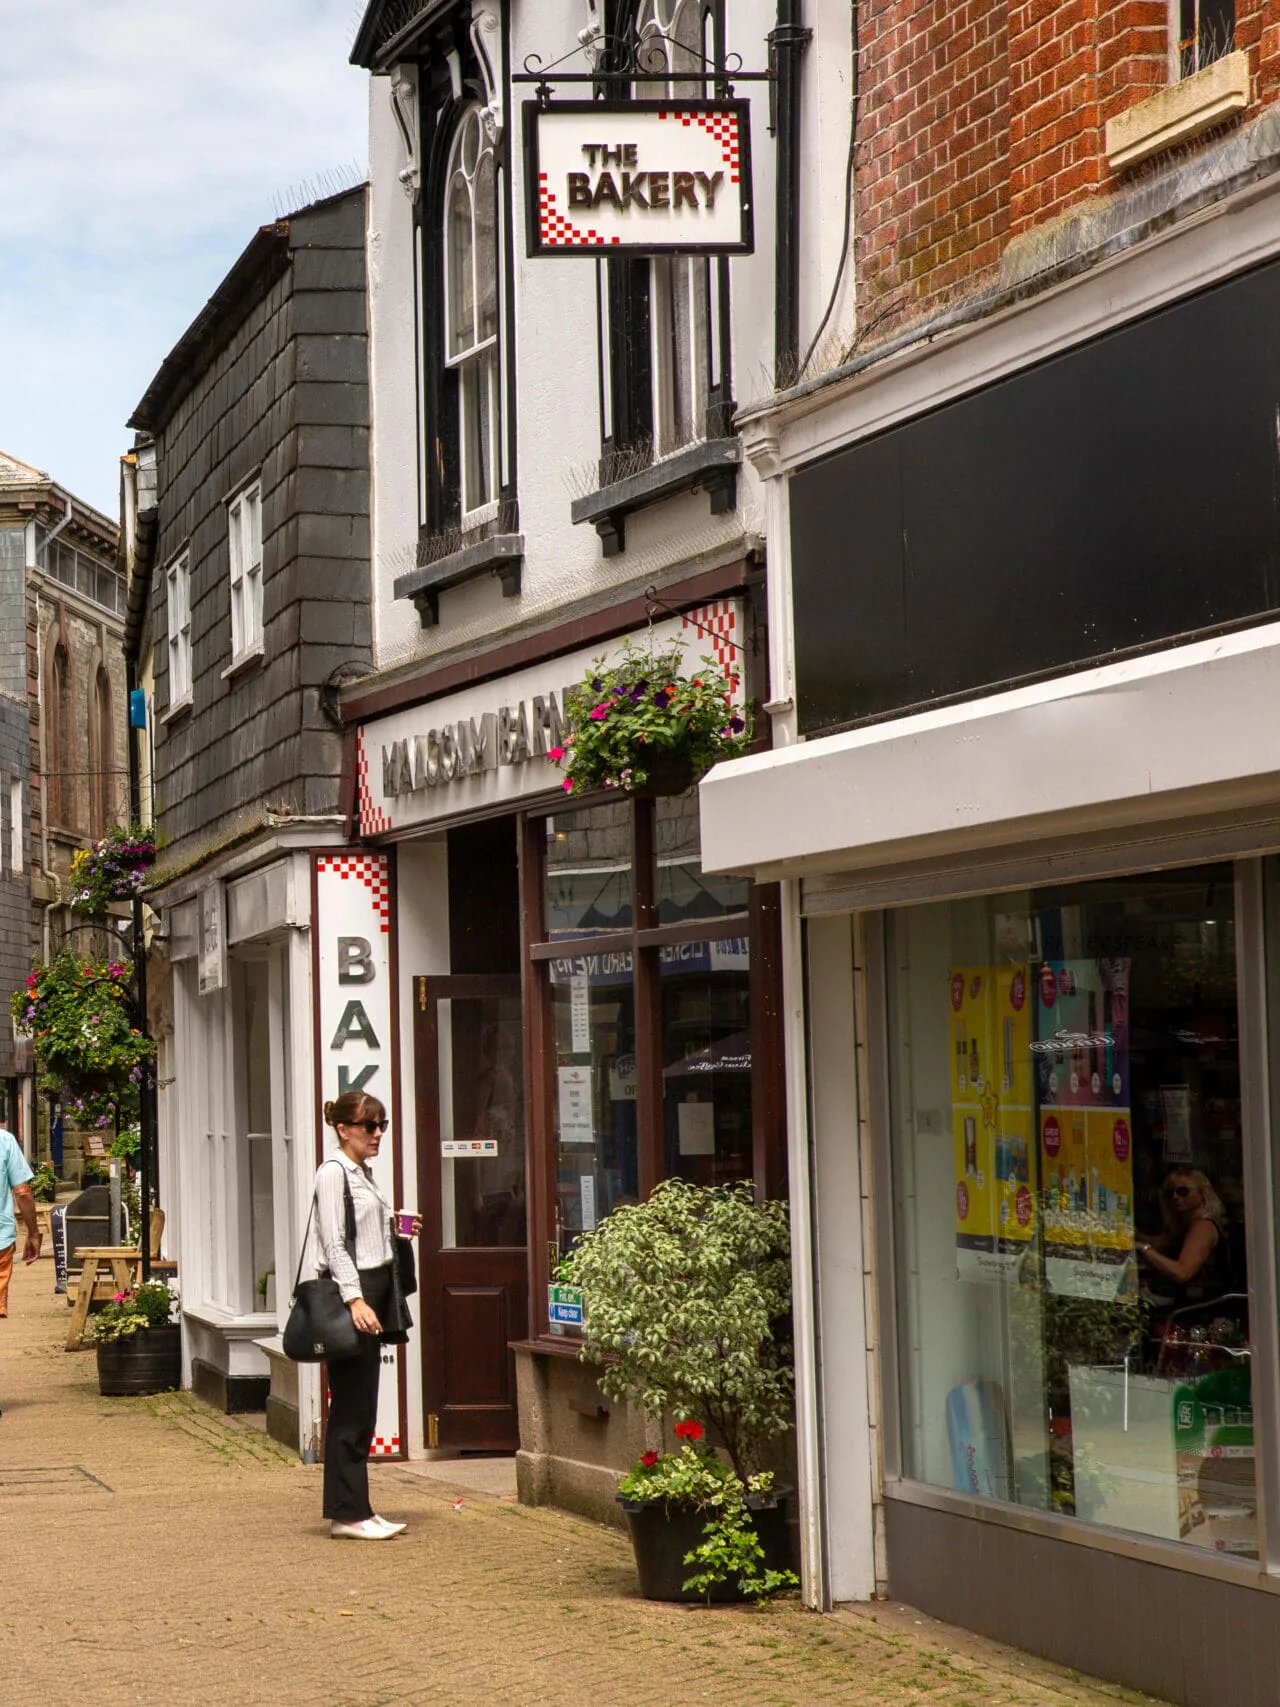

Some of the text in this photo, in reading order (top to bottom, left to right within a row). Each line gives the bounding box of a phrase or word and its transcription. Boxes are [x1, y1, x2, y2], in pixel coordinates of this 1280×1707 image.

[581, 143, 638, 168] THE
[567, 171, 724, 211] BAKERY
[382, 712, 498, 798] MALCOLM
[330, 936, 381, 1098] BAK
